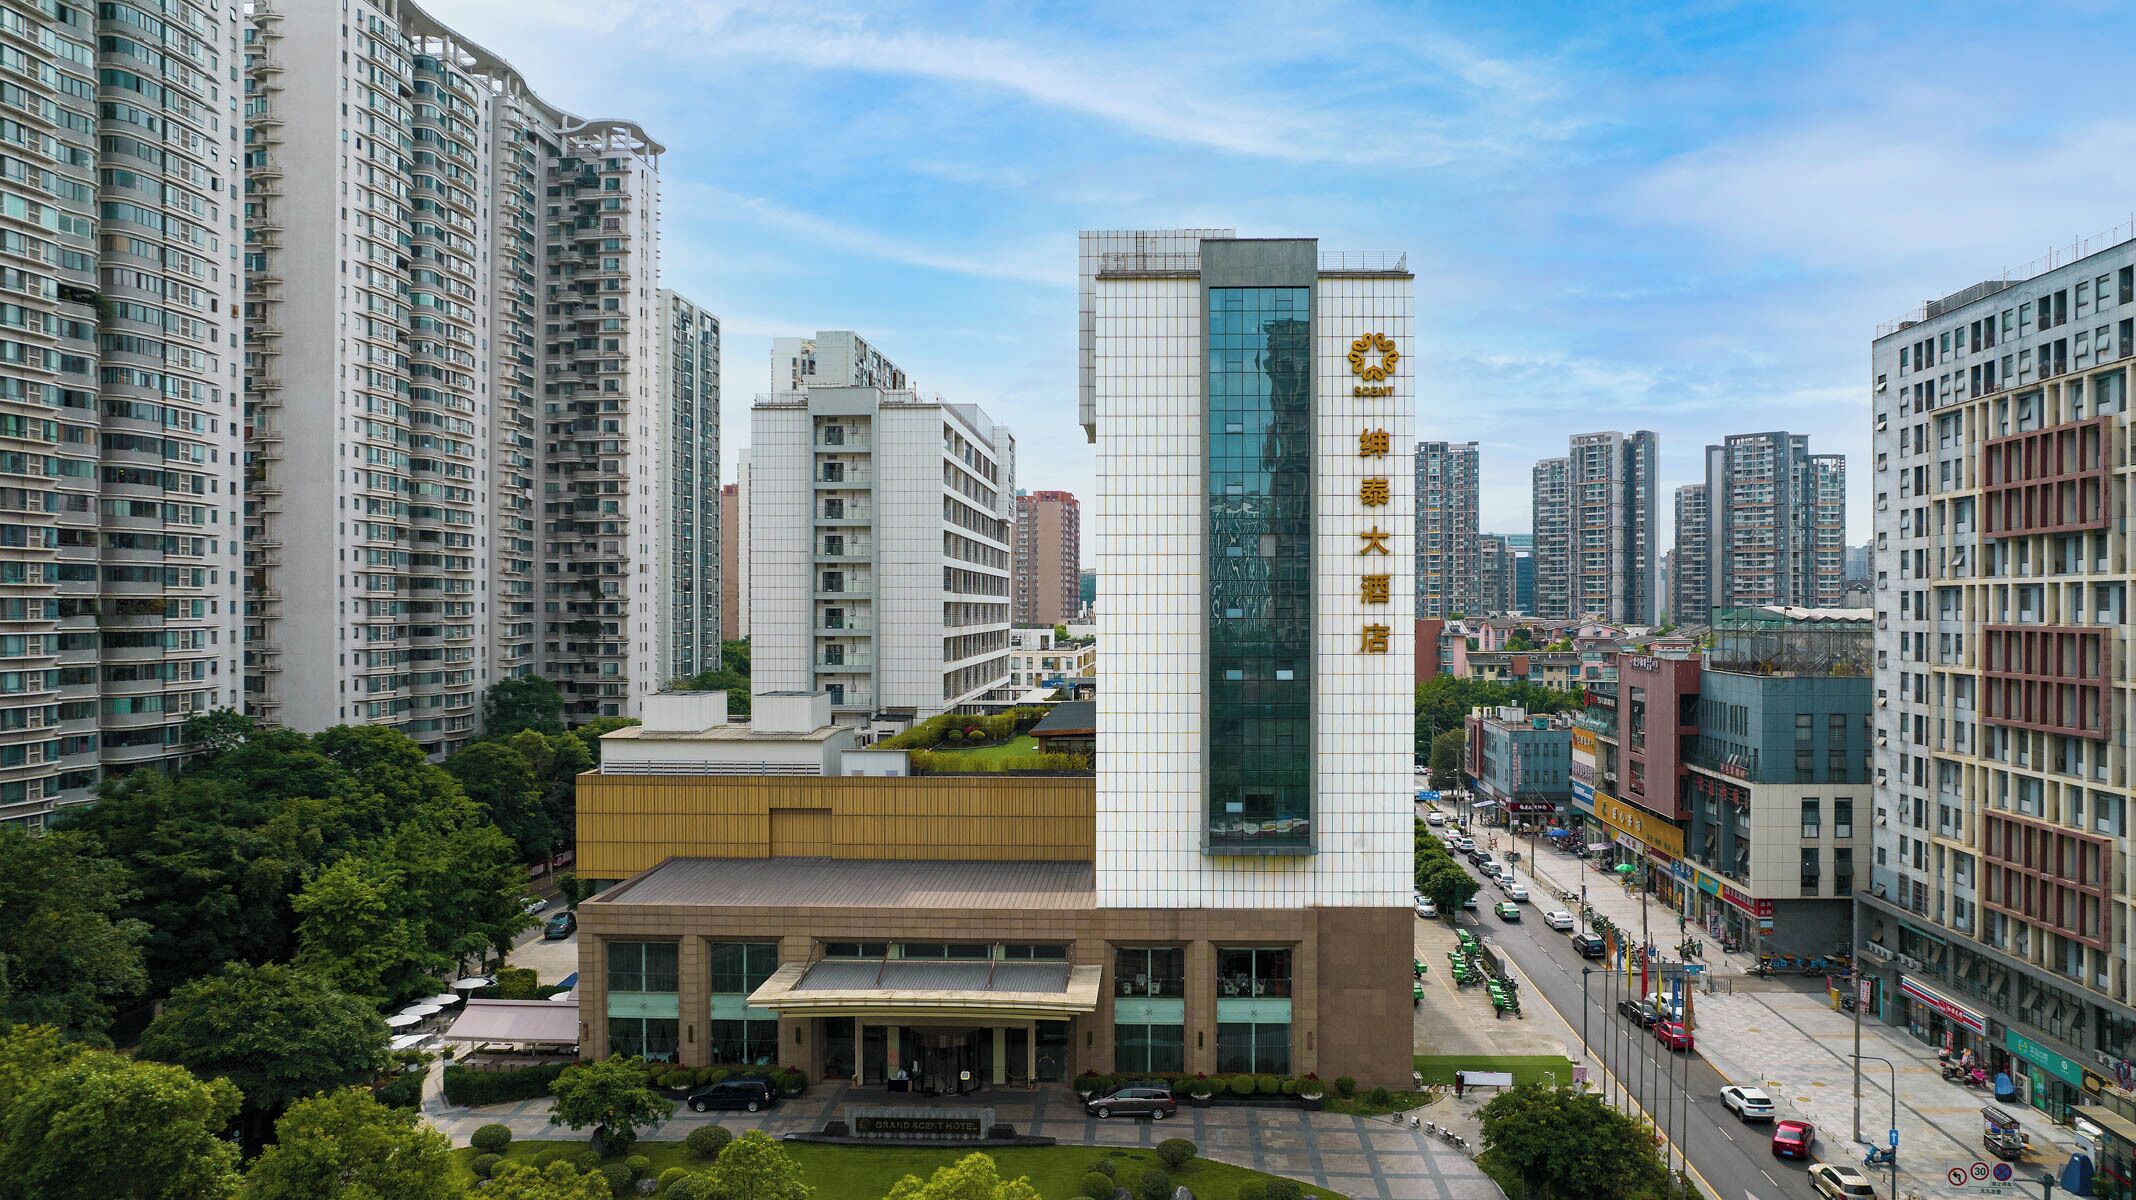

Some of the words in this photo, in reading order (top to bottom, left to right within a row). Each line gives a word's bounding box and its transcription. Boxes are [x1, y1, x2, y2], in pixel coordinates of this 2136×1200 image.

[1354, 386, 1394, 397] SCENT
[1359, 428, 1391, 653] 绅泰大酒店
[875, 1121, 910, 1129] GRAND
[912, 1121, 943, 1130] SCENT
[945, 1122, 978, 1130] HOTEL
[1974, 1167, 1986, 1176] 30
